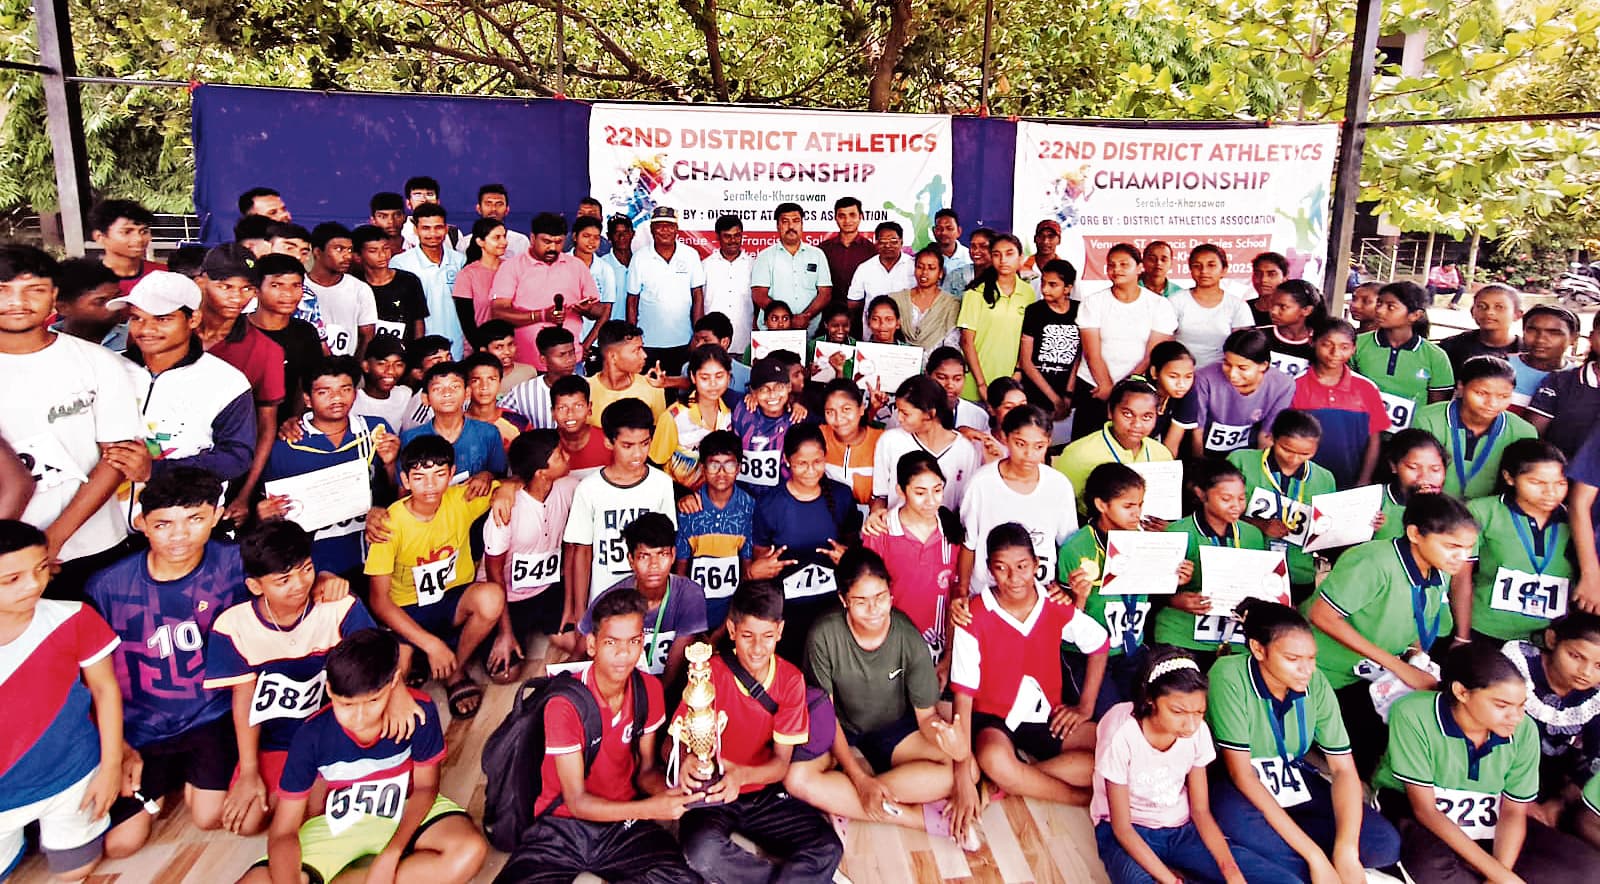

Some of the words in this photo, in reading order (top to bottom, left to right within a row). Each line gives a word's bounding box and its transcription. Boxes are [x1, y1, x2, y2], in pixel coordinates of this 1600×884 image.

[604, 125, 672, 148] 22ND
[681, 128, 797, 151] DISTRICT
[804, 131, 937, 152] ATHLETICS
[1038, 140, 1096, 159] 22ND
[1103, 142, 1203, 161] DISTRICT
[1208, 143, 1323, 162] ATHLETICS
[673, 160, 876, 182] CHAMPIONSHIP
[1094, 170, 1270, 190] CHAMPIONSHIP
[723, 189, 826, 202] Seraikela-Kharsawan
[683, 209, 696, 220] BY
[1080, 215, 1099, 226] ORG
[1102, 215, 1113, 226] BY
[1123, 215, 1164, 226] DISTRICT
[1168, 215, 1217, 226] ATHLETICS
[1220, 215, 1276, 225] ASSOCIATION
[1235, 237, 1267, 249] School
[513, 555, 559, 581] 549
[694, 565, 737, 589] 564
[147, 621, 203, 659] 10
[256, 681, 321, 712] 582
[331, 783, 401, 819] 550
